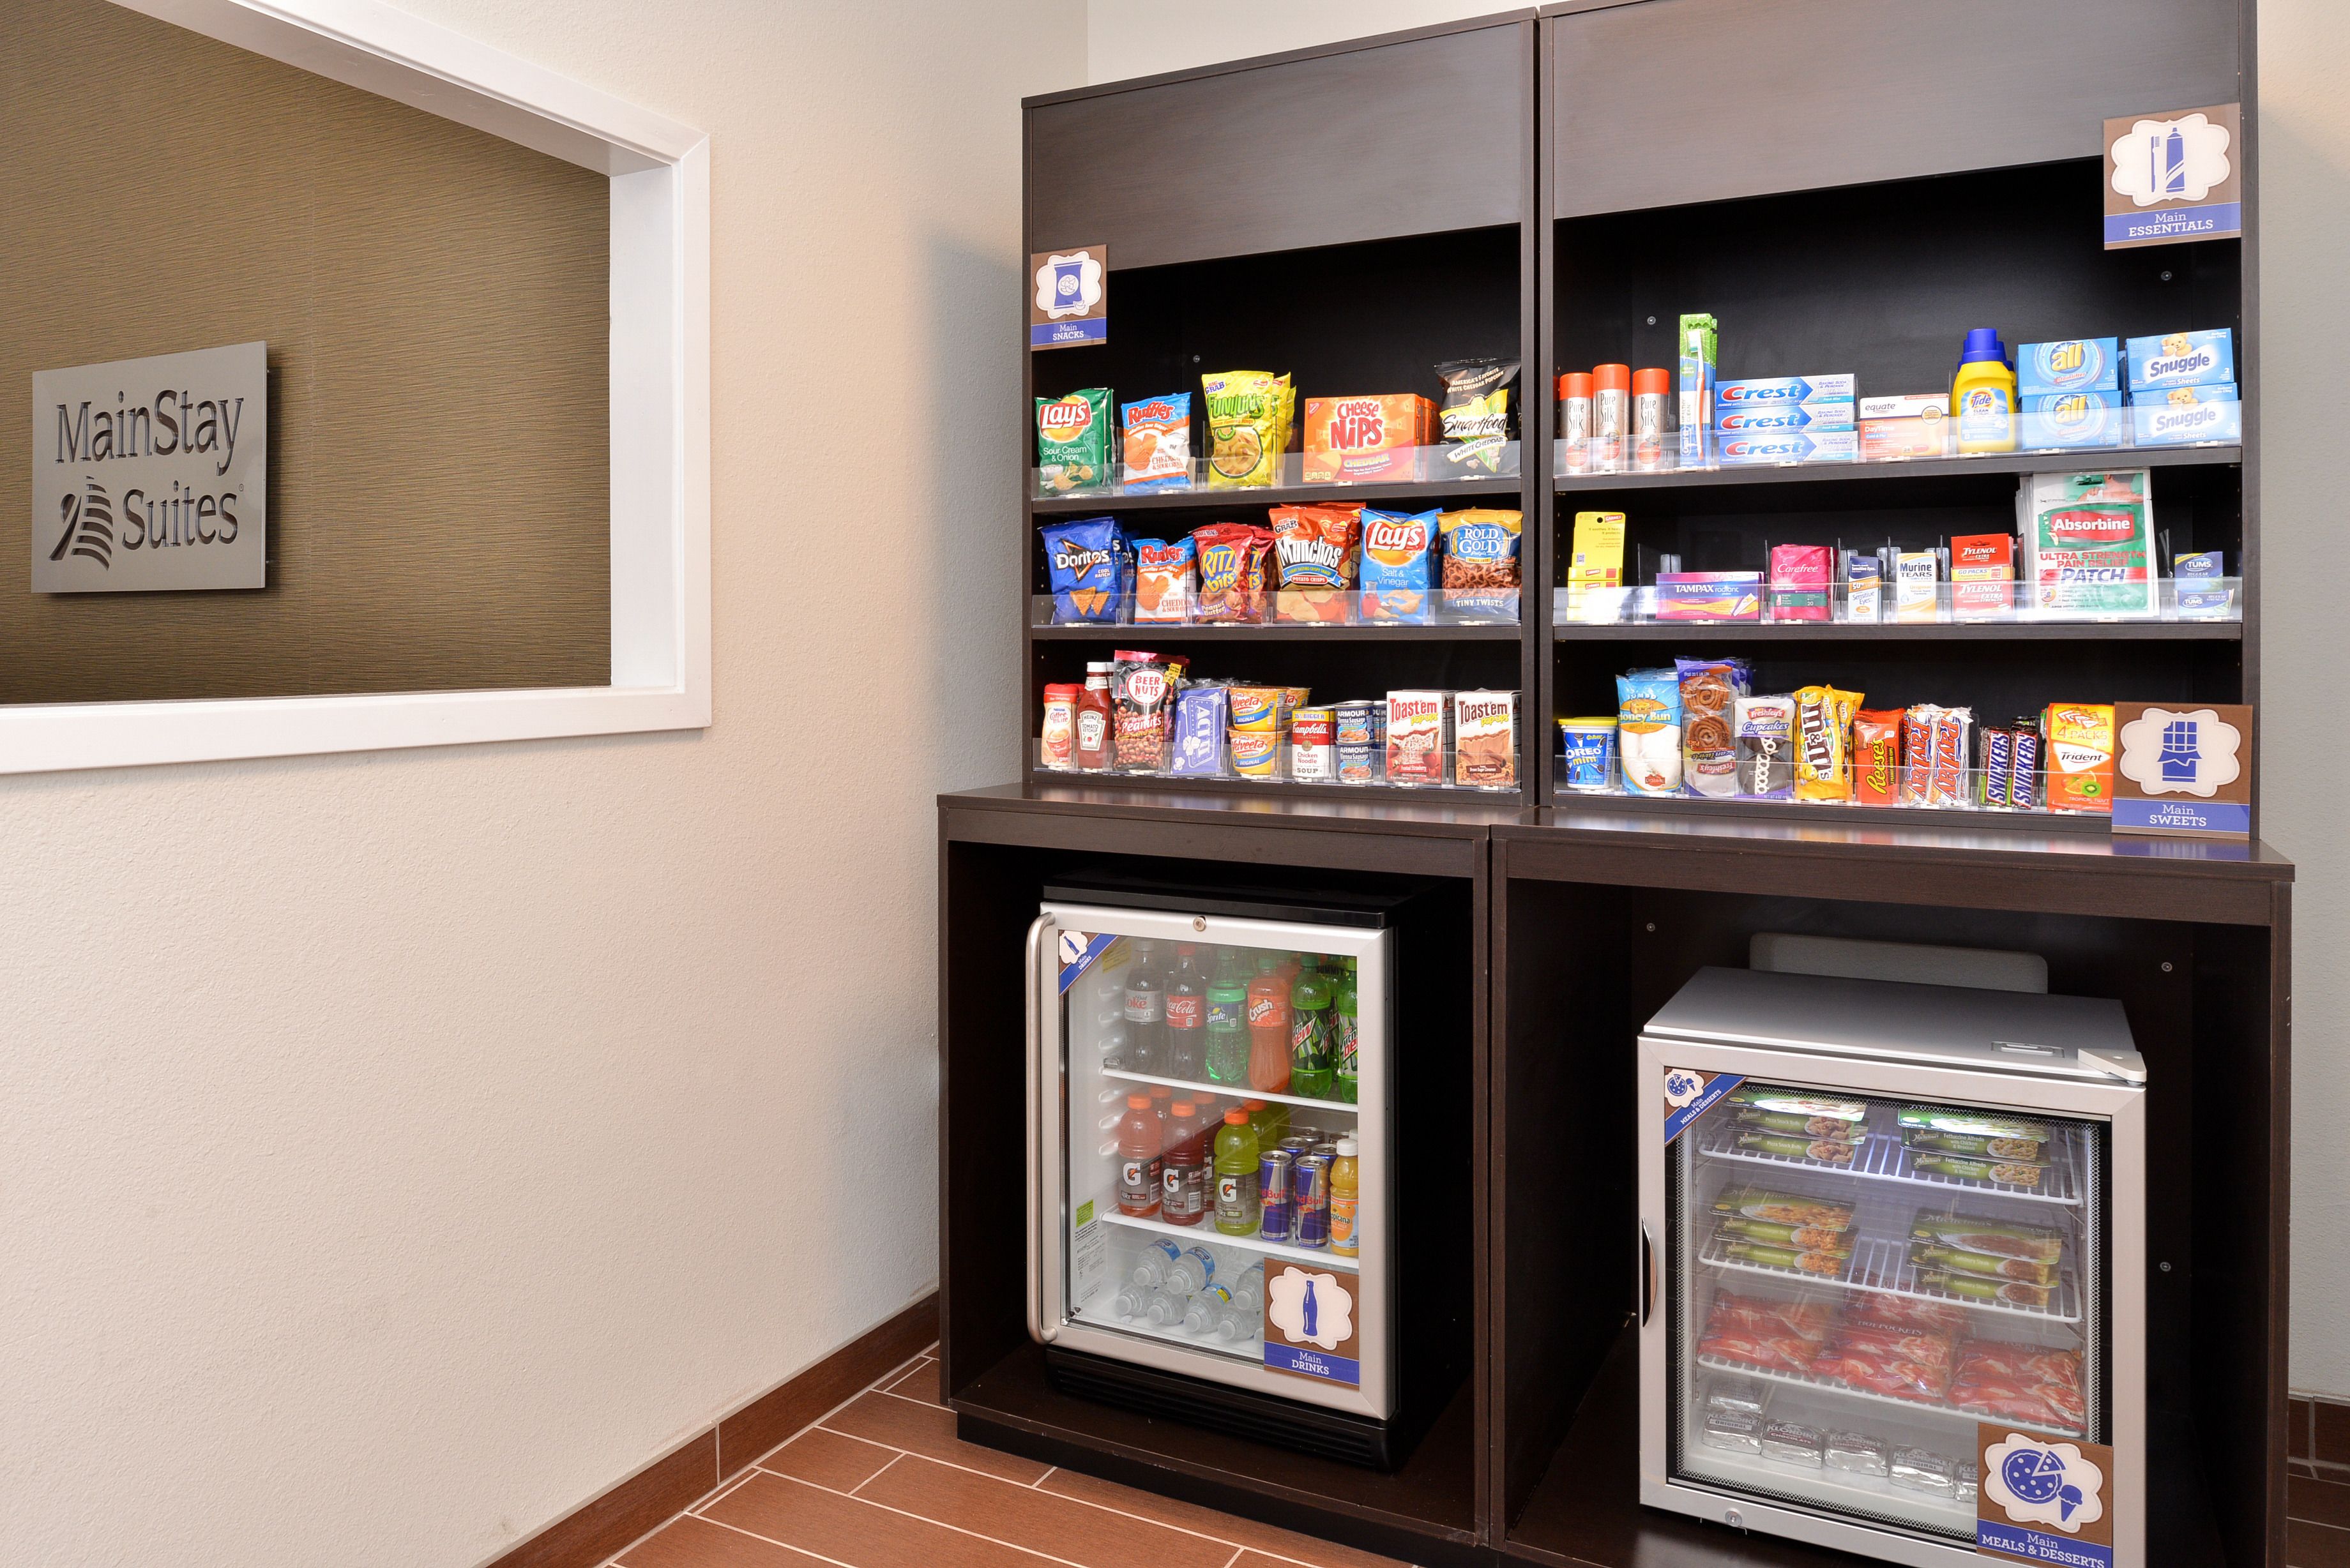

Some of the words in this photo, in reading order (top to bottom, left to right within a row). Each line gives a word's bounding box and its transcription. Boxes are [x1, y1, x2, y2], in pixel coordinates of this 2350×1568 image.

[2155, 213, 2187, 223] Main
[2128, 220, 2213, 236] ESSENTIALS
[1052, 331, 1084, 340] SNACKS
[2051, 342, 2083, 371] all
[2150, 353, 2210, 377] Snuggle
[1206, 382, 1225, 394] GRAB
[1723, 385, 1799, 401] Crest
[1569, 400, 1584, 412] Pure
[1600, 393, 1615, 405] Pure
[1641, 396, 1656, 409] Pure
[1971, 395, 1992, 409] Tide
[1128, 402, 1174, 425] Ruffles
[1865, 403, 1895, 411] equate
[2056, 396, 2087, 423] all
[1042, 403, 1087, 428] Lay's
[1600, 407, 1615, 426] Silk
[1641, 411, 1656, 430] Silk
[1722, 414, 1798, 429] Crest
[2156, 408, 2216, 431] Snuggle
[1444, 414, 1507, 435] Smartfood
[1569, 414, 1584, 433] Silk
[55, 389, 244, 476] MainStay
[1455, 446, 1474, 458] WHITE
[1475, 437, 1503, 448] CHEDDAR
[1726, 441, 1803, 455] Crest
[1344, 454, 1390, 467] CHEDDAR
[122, 480, 238, 550] Suites
[2054, 518, 2130, 531] Absorbine
[1369, 522, 1421, 550] Lay's
[1464, 529, 1498, 539] ROLD
[1277, 536, 1343, 568] Munchos
[1459, 540, 1500, 554] GOLD
[1962, 548, 1996, 557] TYLENOL
[1057, 550, 1110, 568] Doritos
[2082, 551, 2146, 559] STRENGTH
[1202, 551, 1236, 577] RITZ
[1778, 564, 1818, 573] Carefree
[1900, 563, 1931, 571] Murine
[1207, 573, 1235, 591] bits
[1377, 577, 1409, 587] Vinegar
[2061, 569, 2125, 584] PATCH
[1675, 585, 1714, 593] TAMPAX
[1960, 585, 2001, 596] TYLENOL
[1202, 601, 1224, 610] Peanut
[1135, 675, 1160, 685] BEER
[1135, 685, 1158, 696] NUTS
[1390, 699, 1437, 723] Toast'em
[1459, 701, 1507, 725] Toast'em
[1751, 708, 1783, 716] Freshley's
[1197, 705, 1211, 737] ACT
[1743, 721, 1789, 732] Cupcakes
[1293, 723, 1328, 735] Campbell's
[2058, 726, 2066, 739] 4
[2070, 730, 2107, 739] PACKS
[1197, 739, 1210, 757] II
[1567, 748, 1601, 758] OREO
[1573, 756, 1596, 765] mini
[2061, 752, 2102, 762] Trident
[1700, 762, 1733, 773] Freshley's
[1867, 739, 1886, 794] Reese's
[1989, 733, 2009, 801] SNICKERS
[2013, 735, 2036, 804] SNICKERS
[2162, 804, 2194, 815] Main
[2149, 815, 2206, 826] SWEETS
[1078, 955, 1087, 964] Main
[1079, 956, 1092, 970] DRINKS
[1249, 1000, 1273, 1021] Crush
[1208, 1013, 1226, 1023] Sprite
[1680, 1110, 1696, 1124] MEALS
[1699, 1089, 1722, 1110] DESSERTS
[1691, 1099, 1703, 1108] Main
[1946, 1157, 1968, 1166] Fettuccine
[1307, 1195, 1323, 1204] Bull
[1300, 1352, 1321, 1364] Main
[1292, 1360, 1329, 1375] DRINKS
[1770, 1433, 1812, 1444] CHOCOLATE
[2027, 1533, 2058, 1549] Main
[1982, 1534, 2025, 1552] MEALS
[2028, 1546, 2036, 1555] &
[2040, 1548, 2104, 1568] DESSERTS
